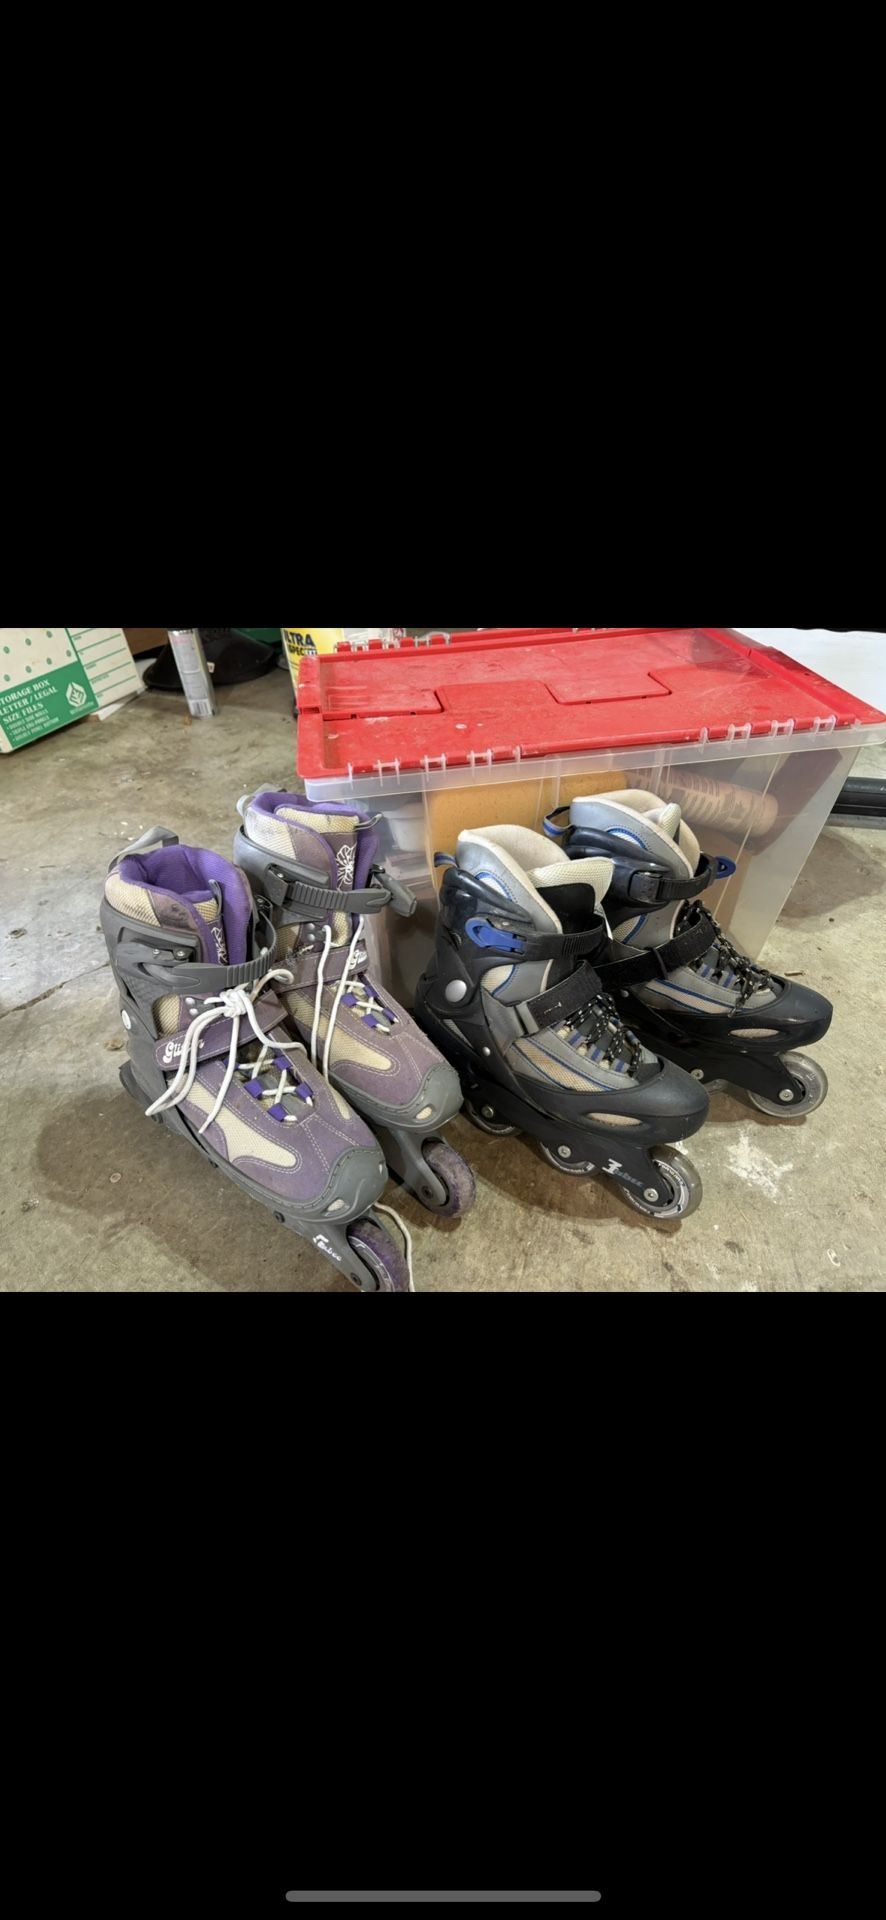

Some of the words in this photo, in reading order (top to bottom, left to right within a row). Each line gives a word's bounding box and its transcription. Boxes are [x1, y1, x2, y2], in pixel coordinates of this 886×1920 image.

[0, 686, 33, 705] TORAGE
[32, 679, 50, 692] BOX
[0, 698, 29, 715] LETTER
[34, 686, 58, 701] LEGAL
[3, 712, 21, 724] SIZE
[22, 702, 44, 717] FILES
